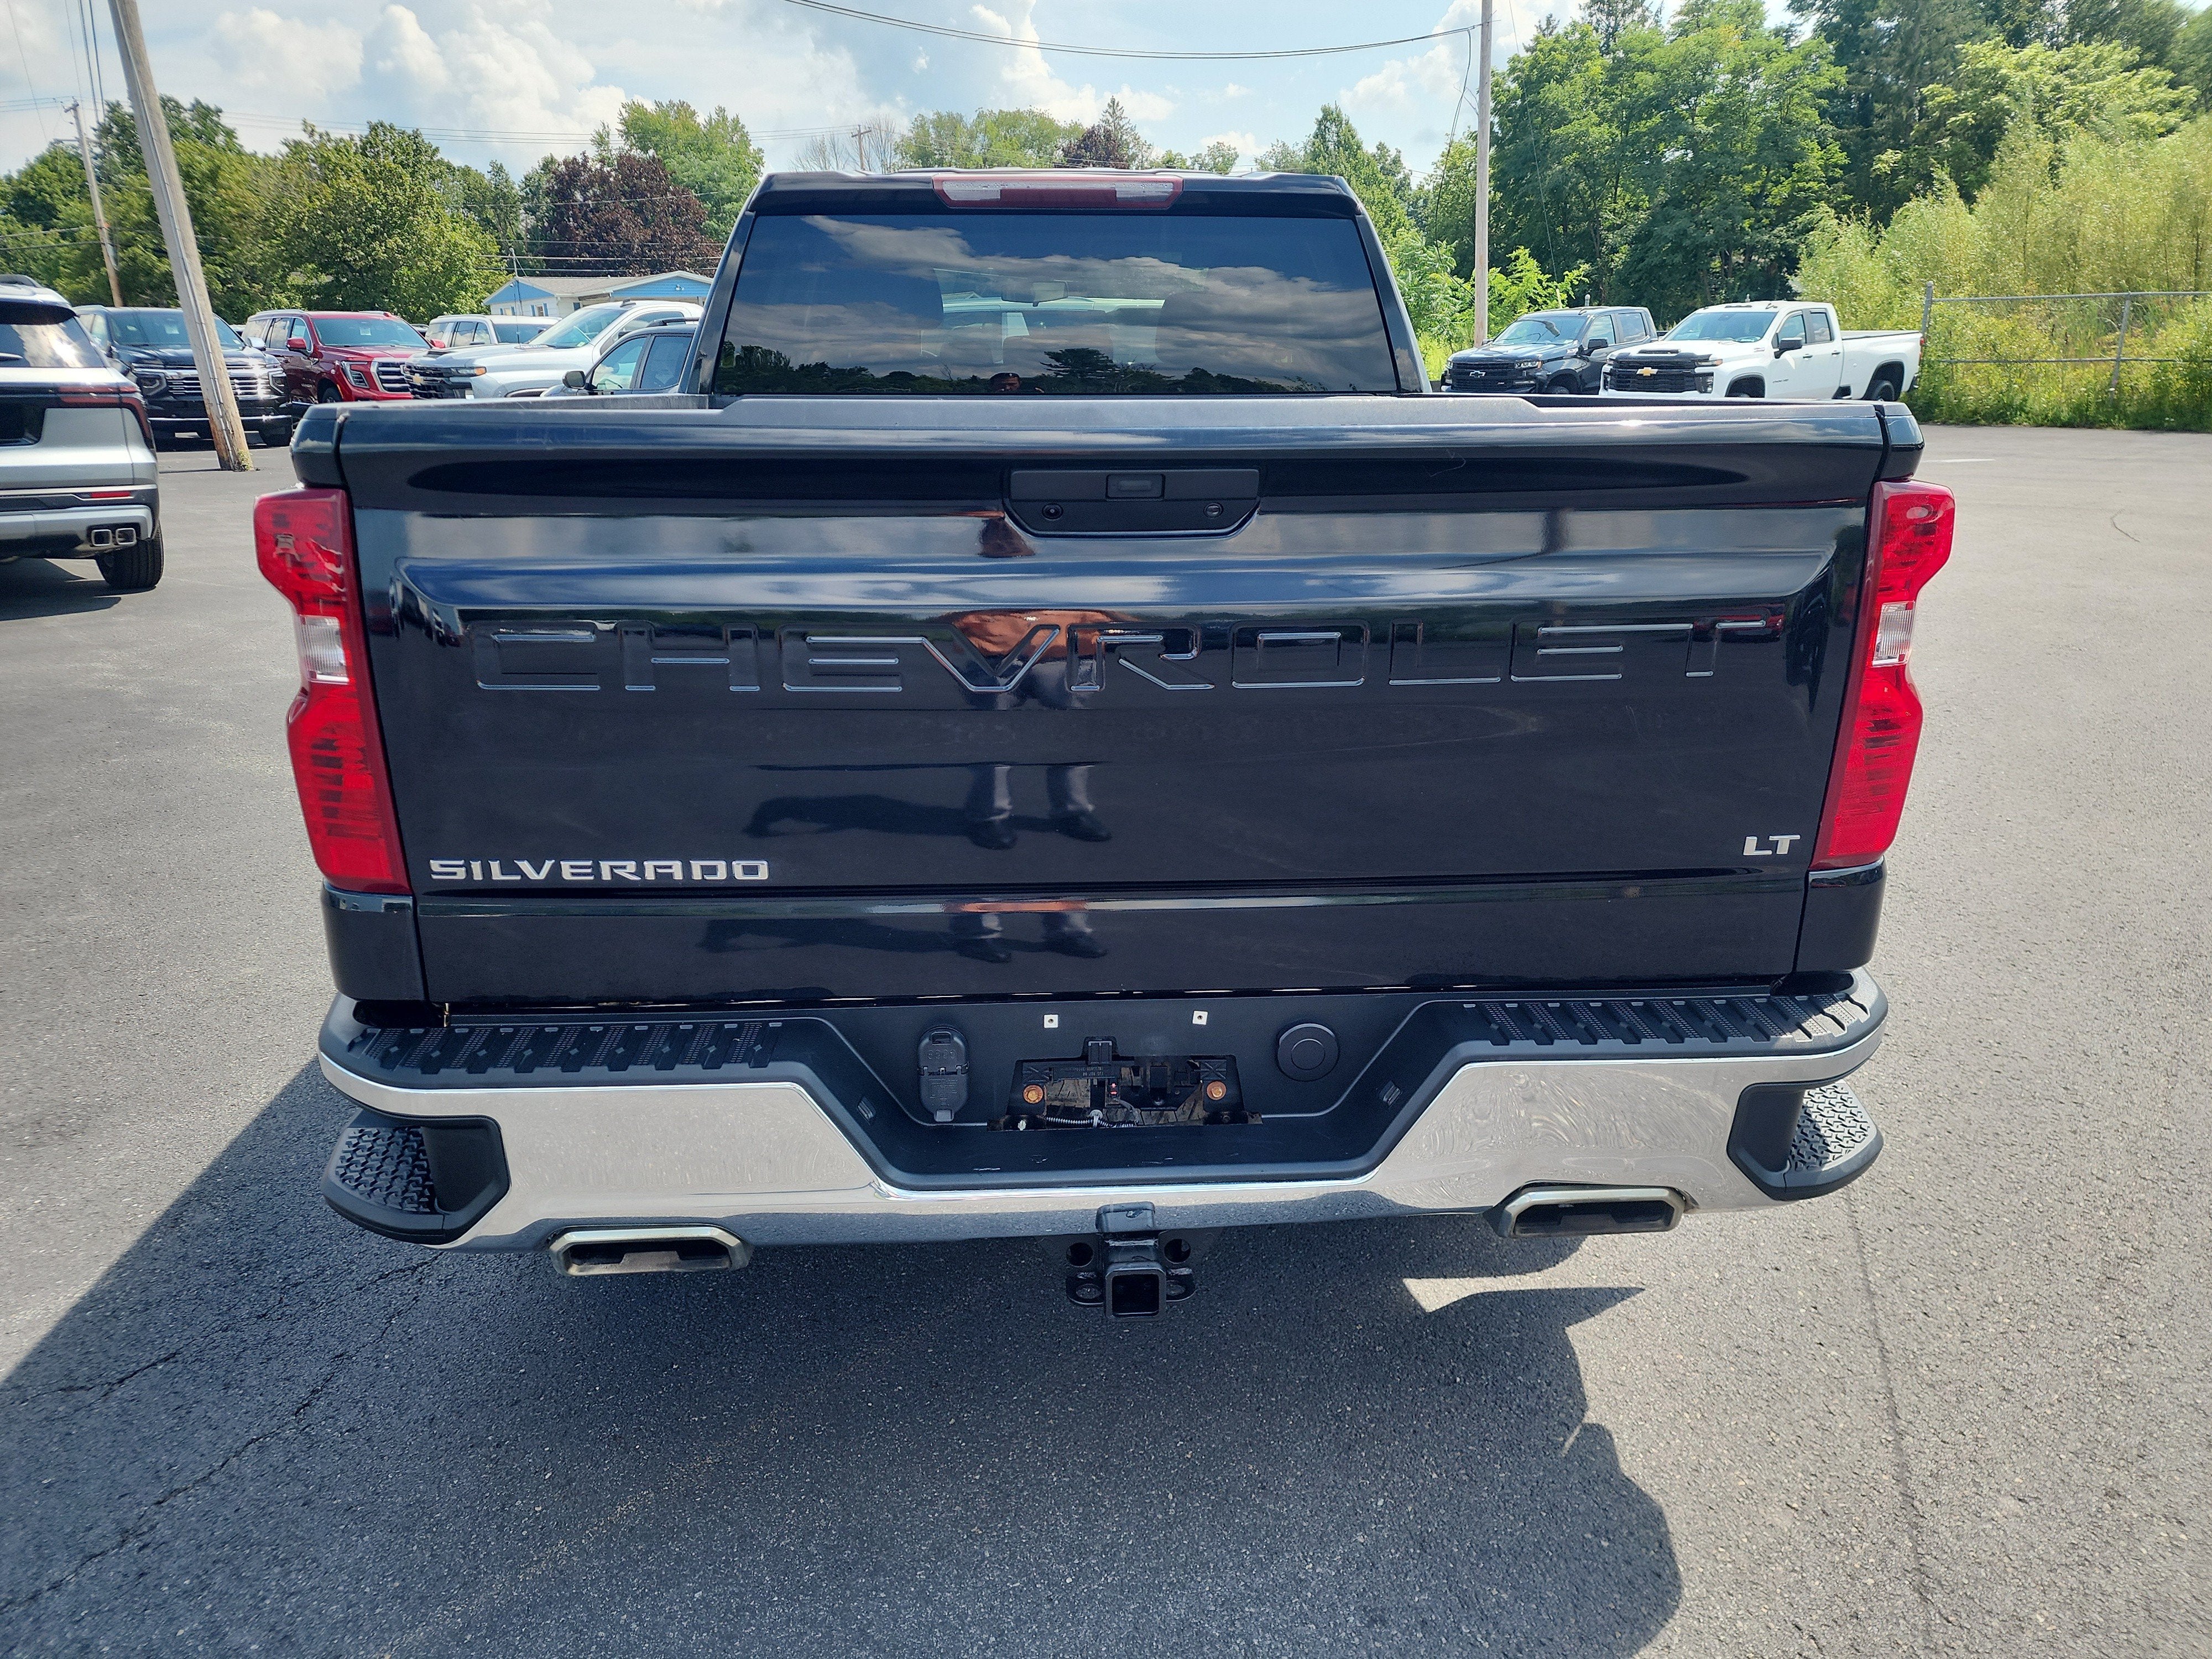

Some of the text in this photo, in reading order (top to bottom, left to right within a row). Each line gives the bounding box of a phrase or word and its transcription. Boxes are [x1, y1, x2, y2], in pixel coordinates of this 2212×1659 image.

[471, 607, 1771, 691] CHEVROLET
[1743, 834, 1801, 855] LT
[429, 859, 770, 881] SILVERADO
